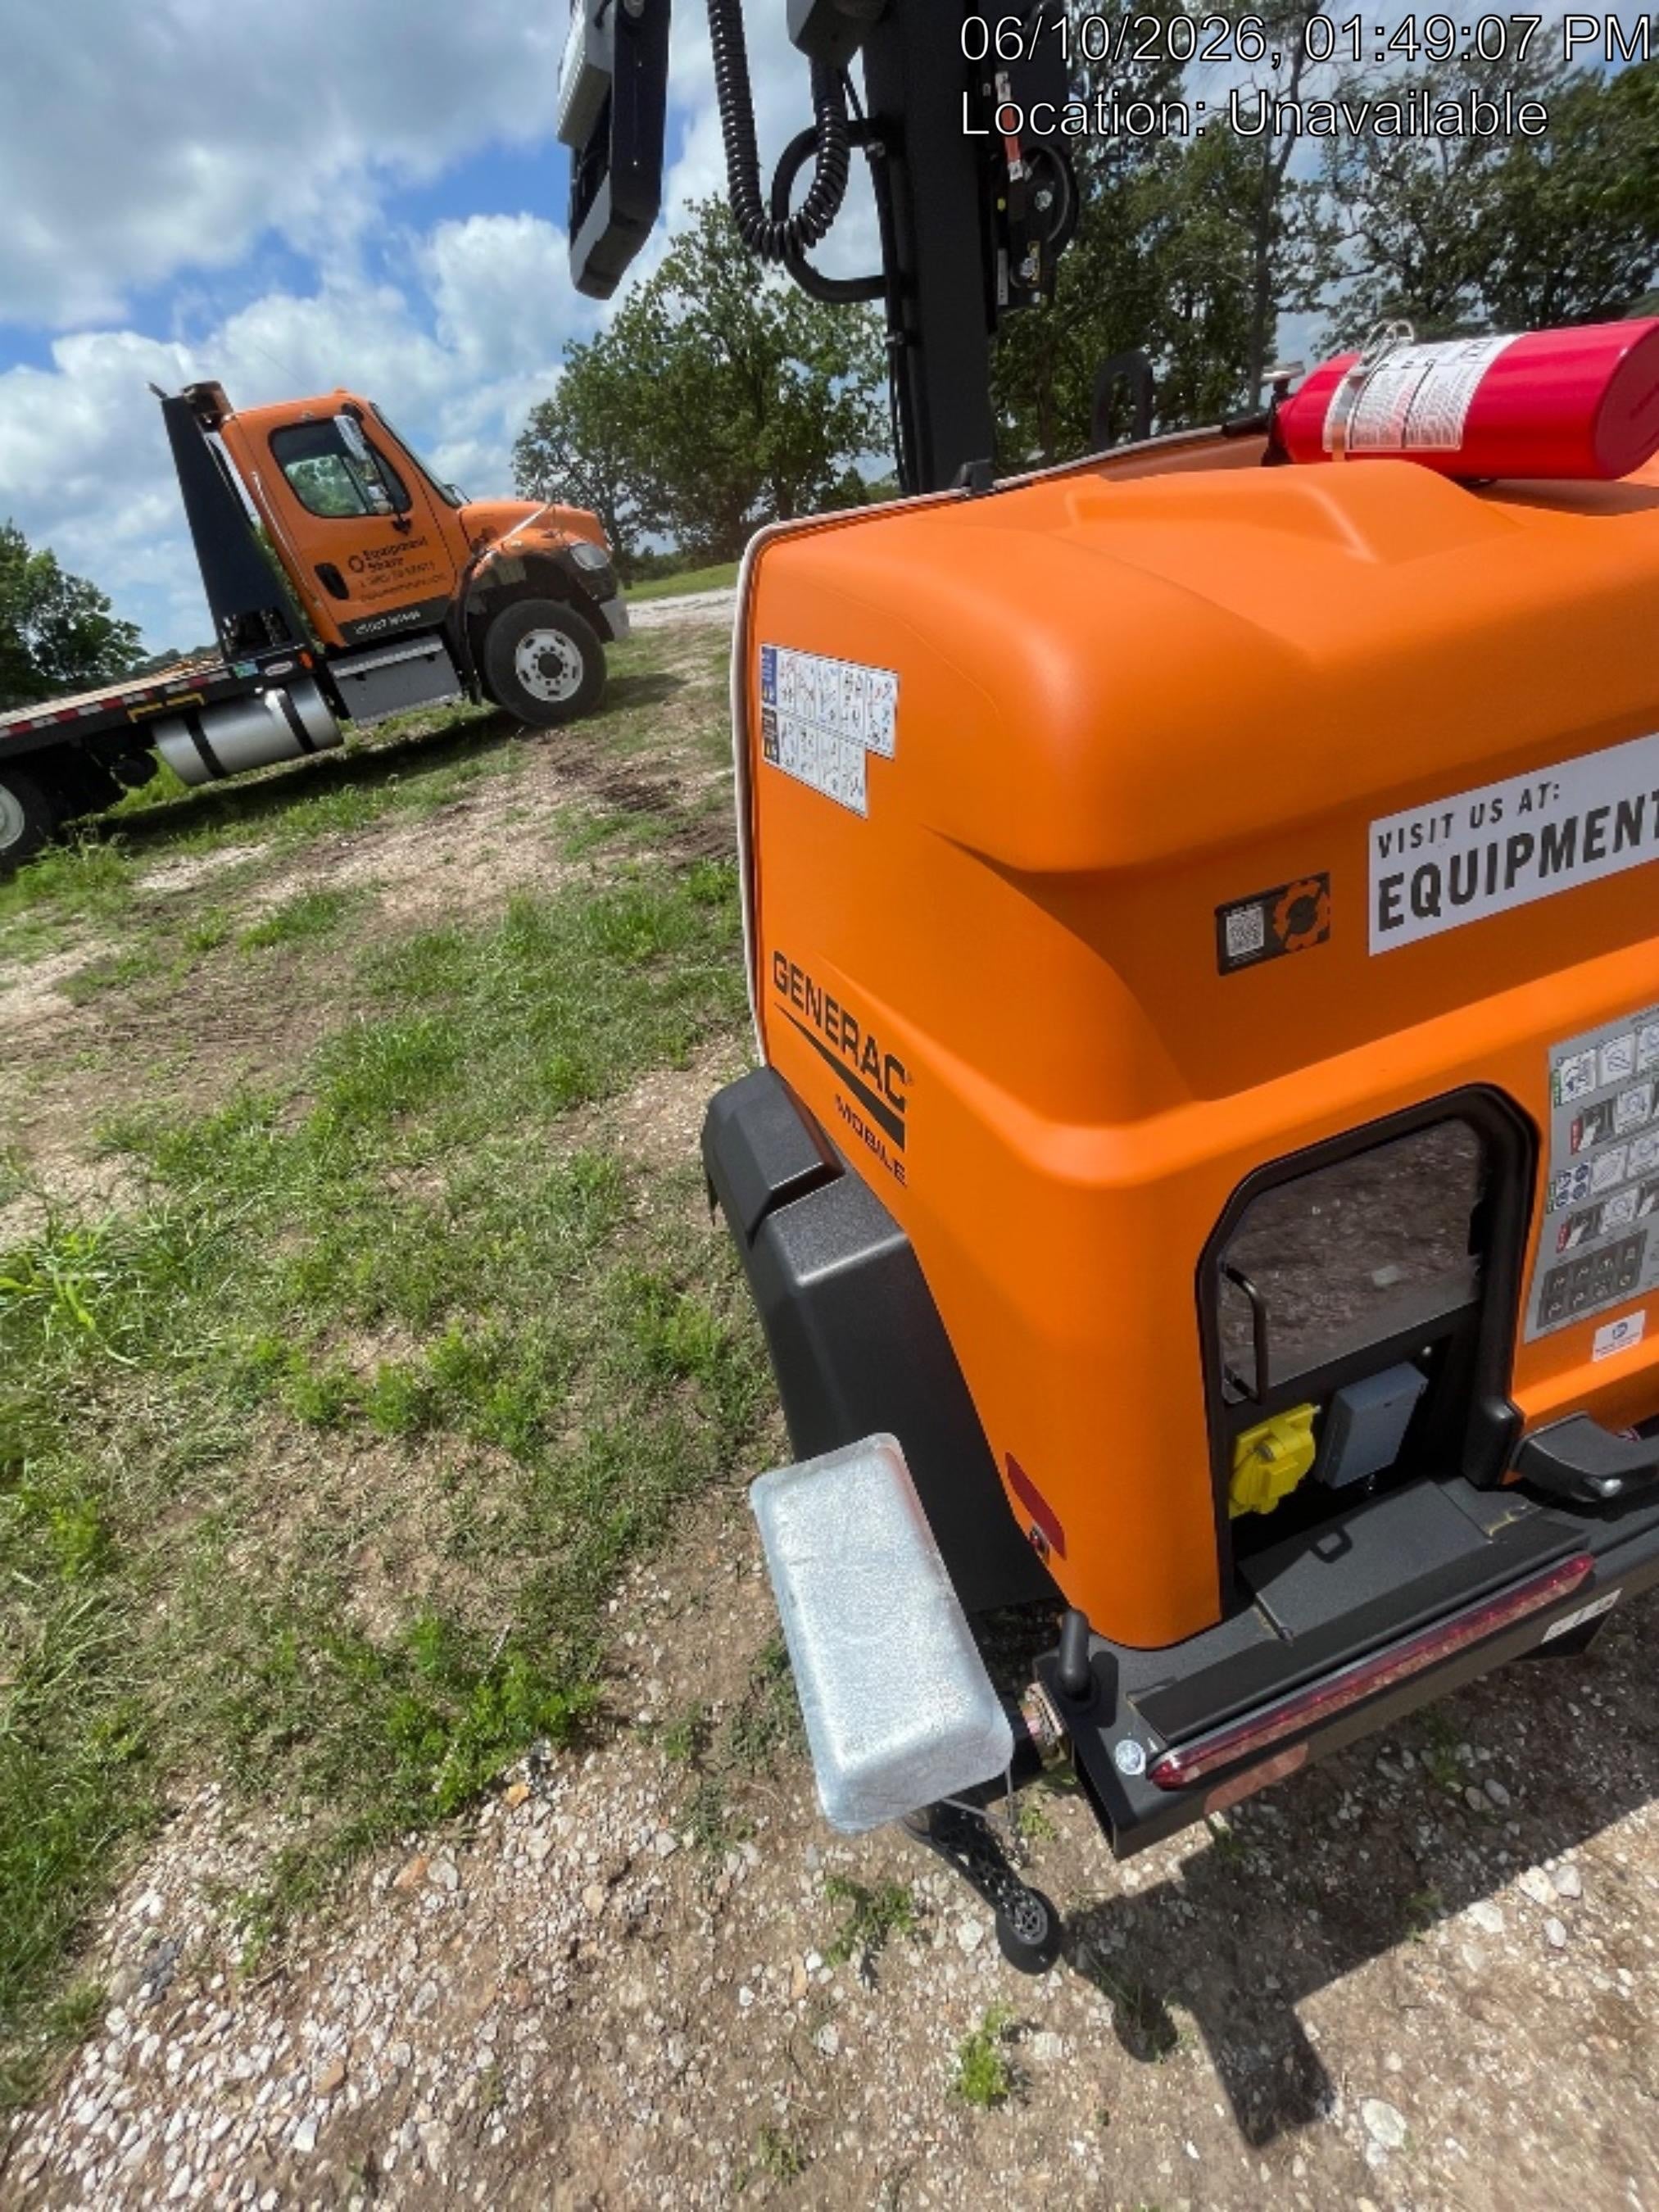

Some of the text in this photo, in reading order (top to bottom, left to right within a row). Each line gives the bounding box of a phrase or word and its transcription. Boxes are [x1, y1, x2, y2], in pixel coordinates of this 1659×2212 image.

[1377, 781, 1561, 859] VISIT US AT:
[773, 950, 906, 1114] GENERAC
[836, 1094, 907, 1185] MOBILE
